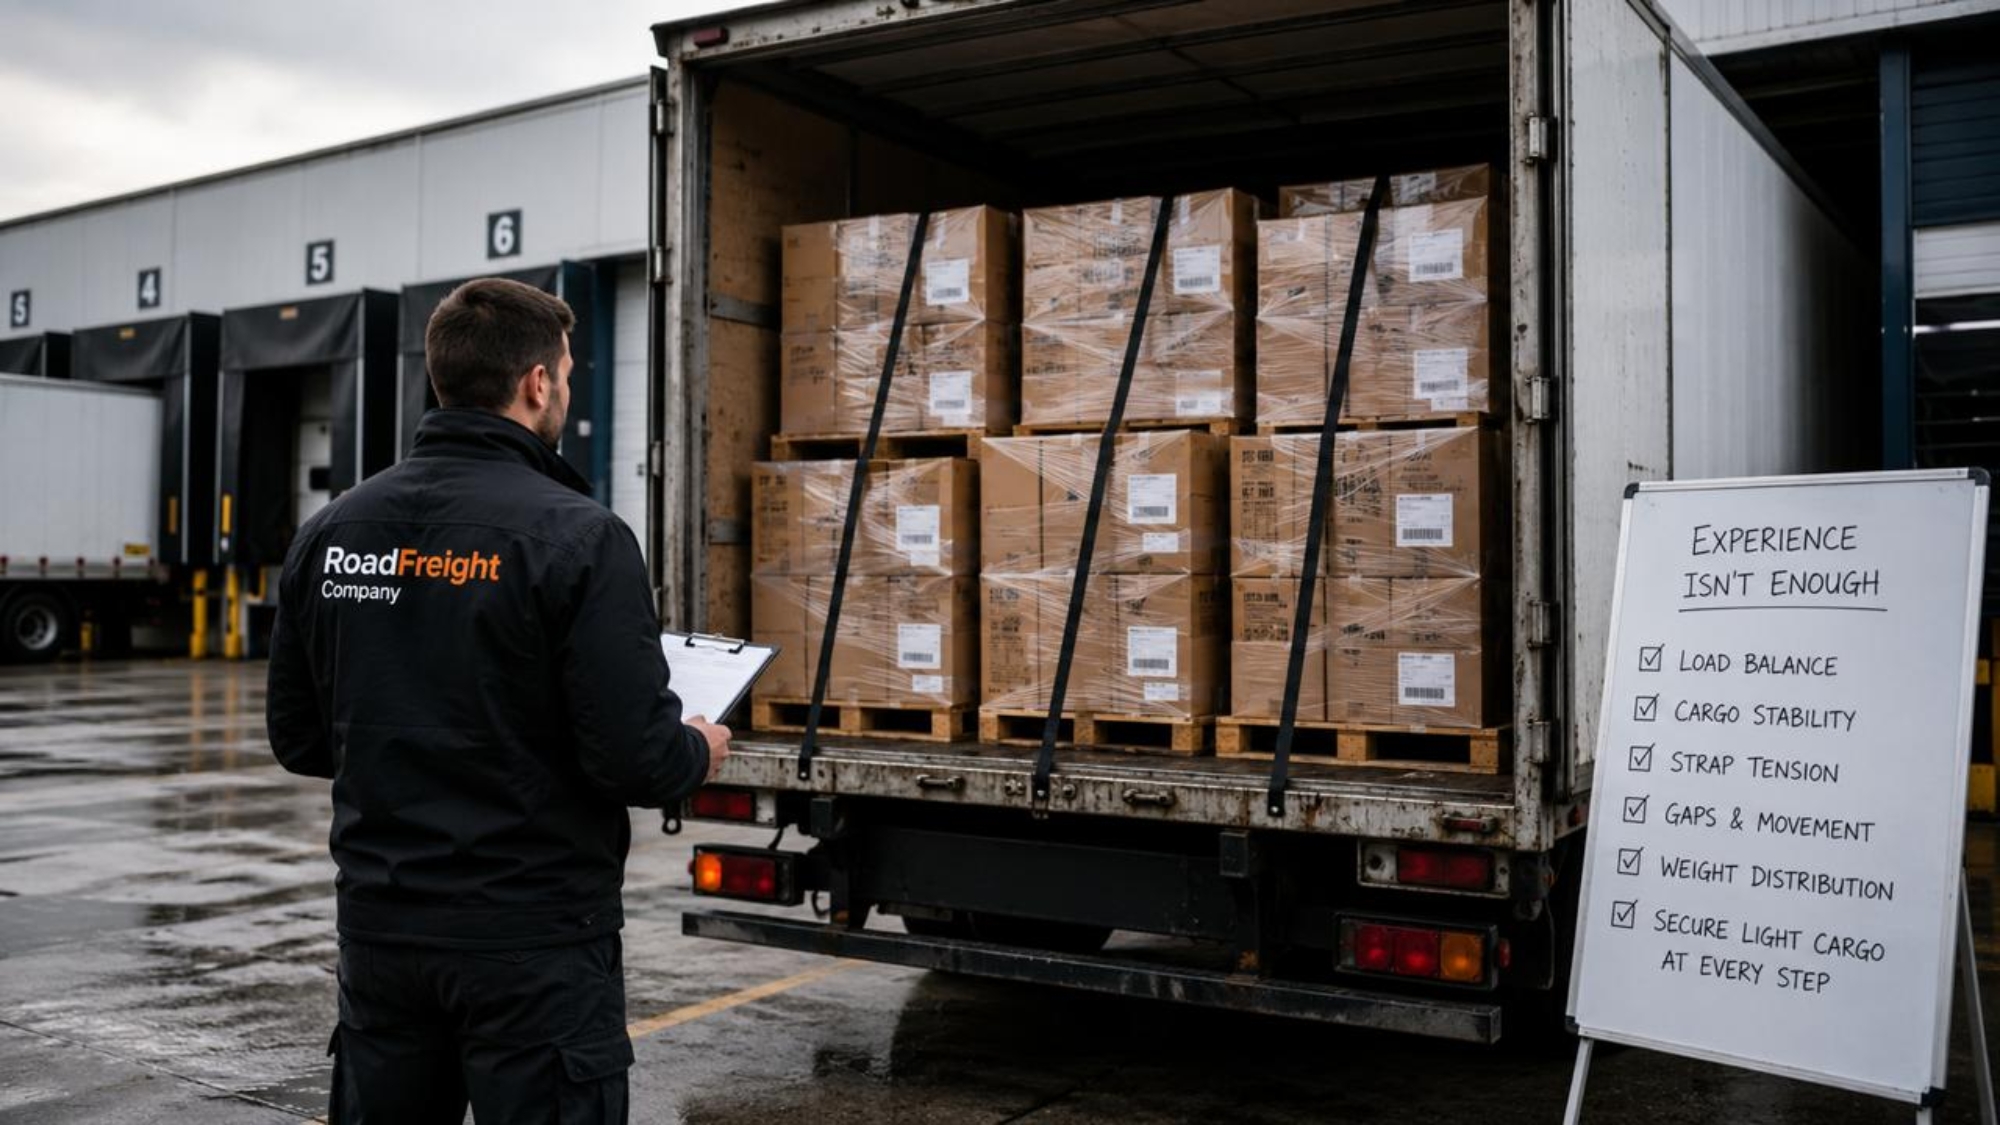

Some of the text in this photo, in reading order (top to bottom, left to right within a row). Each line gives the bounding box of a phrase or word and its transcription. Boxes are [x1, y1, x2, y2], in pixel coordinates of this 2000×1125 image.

[493, 214, 514, 254] 6
[310, 246, 329, 281] 5
[142, 273, 155, 304] 4
[1693, 525, 1856, 555] EXPERIENCE
[323, 546, 502, 585] RoadFreight
[321, 579, 401, 605] Company
[1684, 570, 1878, 598] ISN'T ENOUGH
[1680, 651, 1837, 676] LOAD BALANCE
[1676, 701, 1855, 731] CARGO STABILITY
[1671, 752, 1838, 782] STRAP TENSION
[1666, 803, 1874, 841] GAPS & MOVEMENT
[1662, 857, 1893, 900] WEIGHT DISTRIBUTION
[1655, 910, 1884, 961] SECURE LIGHT CARGO
[1662, 951, 1829, 993] AT EVERY STEP
